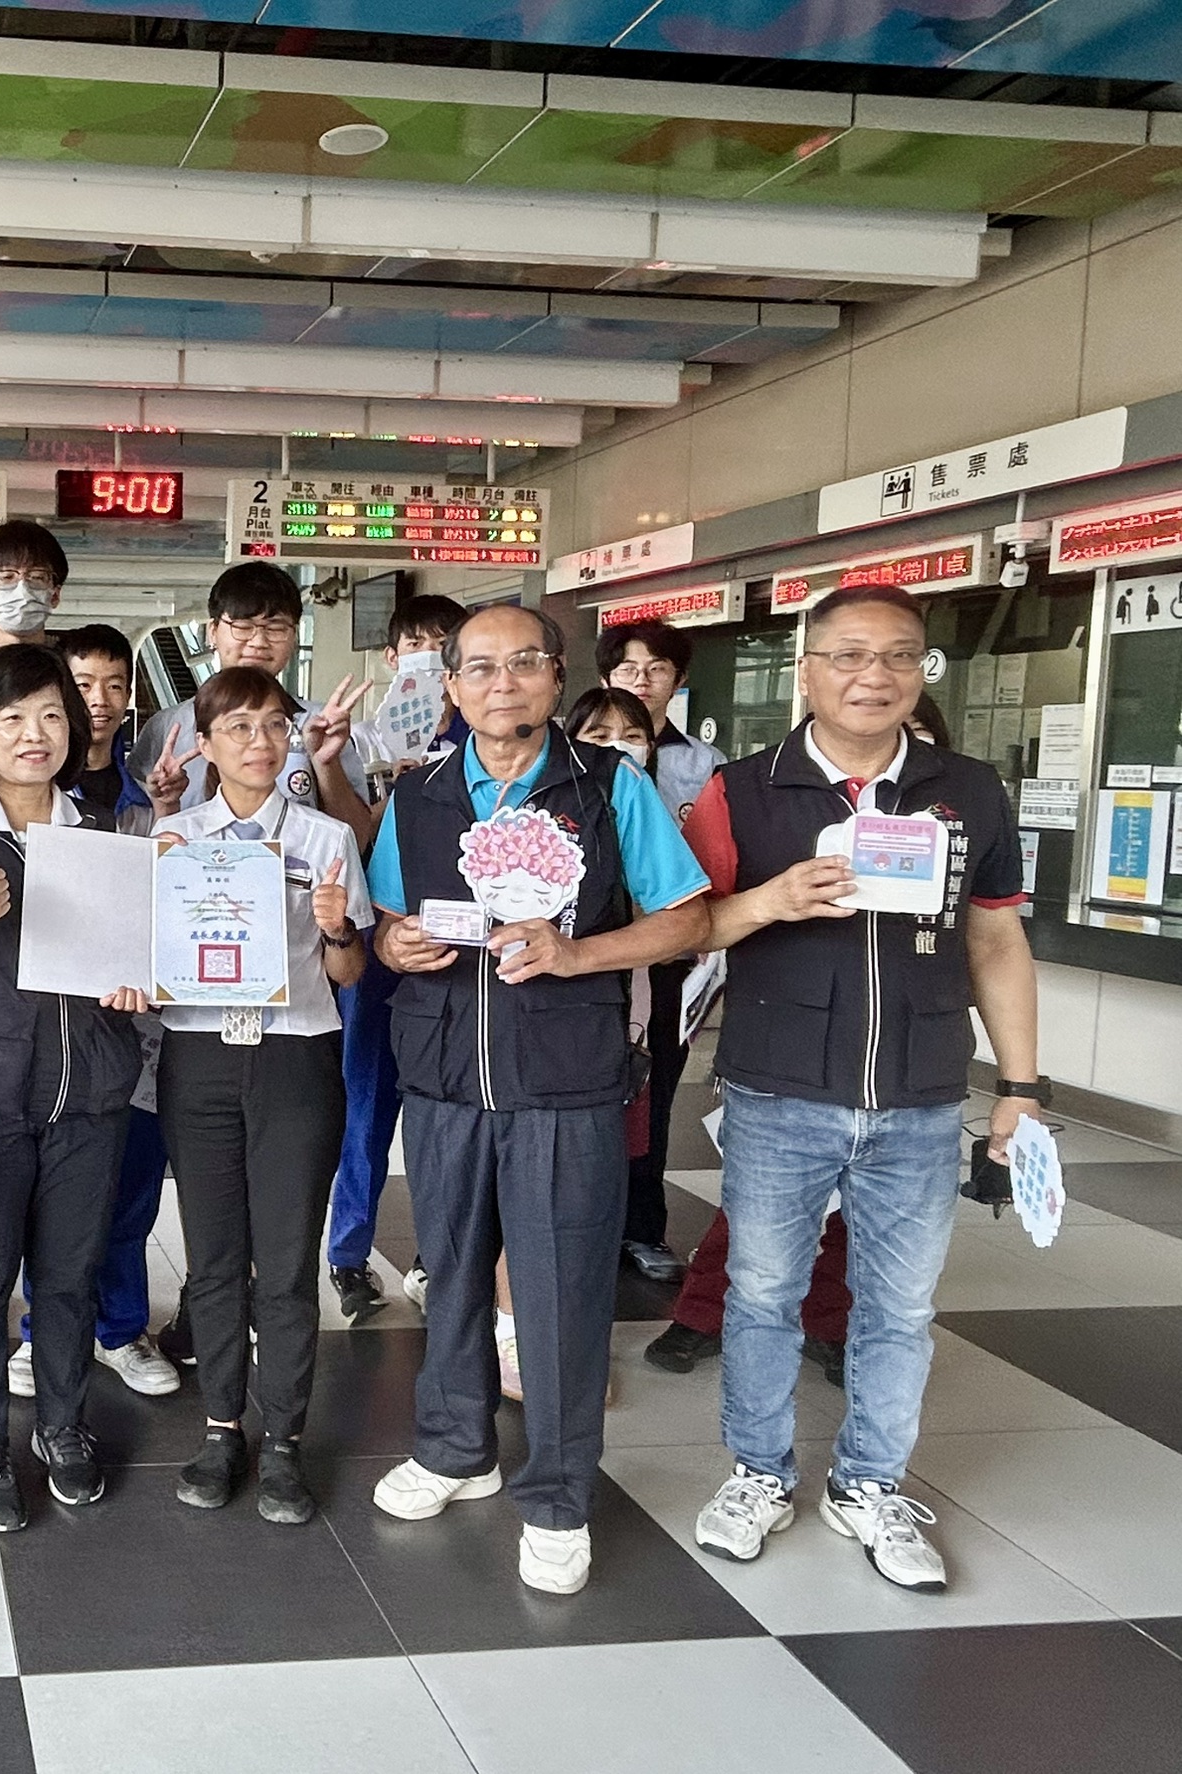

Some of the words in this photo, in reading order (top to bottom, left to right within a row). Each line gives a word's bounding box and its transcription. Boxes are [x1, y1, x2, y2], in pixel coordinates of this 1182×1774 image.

[931, 441, 1029, 487] 售票處
[93, 475, 176, 515] 9:00
[253, 480, 268, 503] 2
[291, 481, 316, 494] 車次
[331, 482, 356, 495] 開往
[370, 484, 394, 497] 經由
[411, 486, 434, 497] 車種
[452, 487, 476, 500] 時間
[482, 488, 504, 500] 月台
[928, 488, 960, 502] Tickets
[248, 506, 271, 518] 月台
[246, 519, 271, 530] Plat.
[603, 540, 651, 566] 補票處
[926, 655, 939, 676] 2
